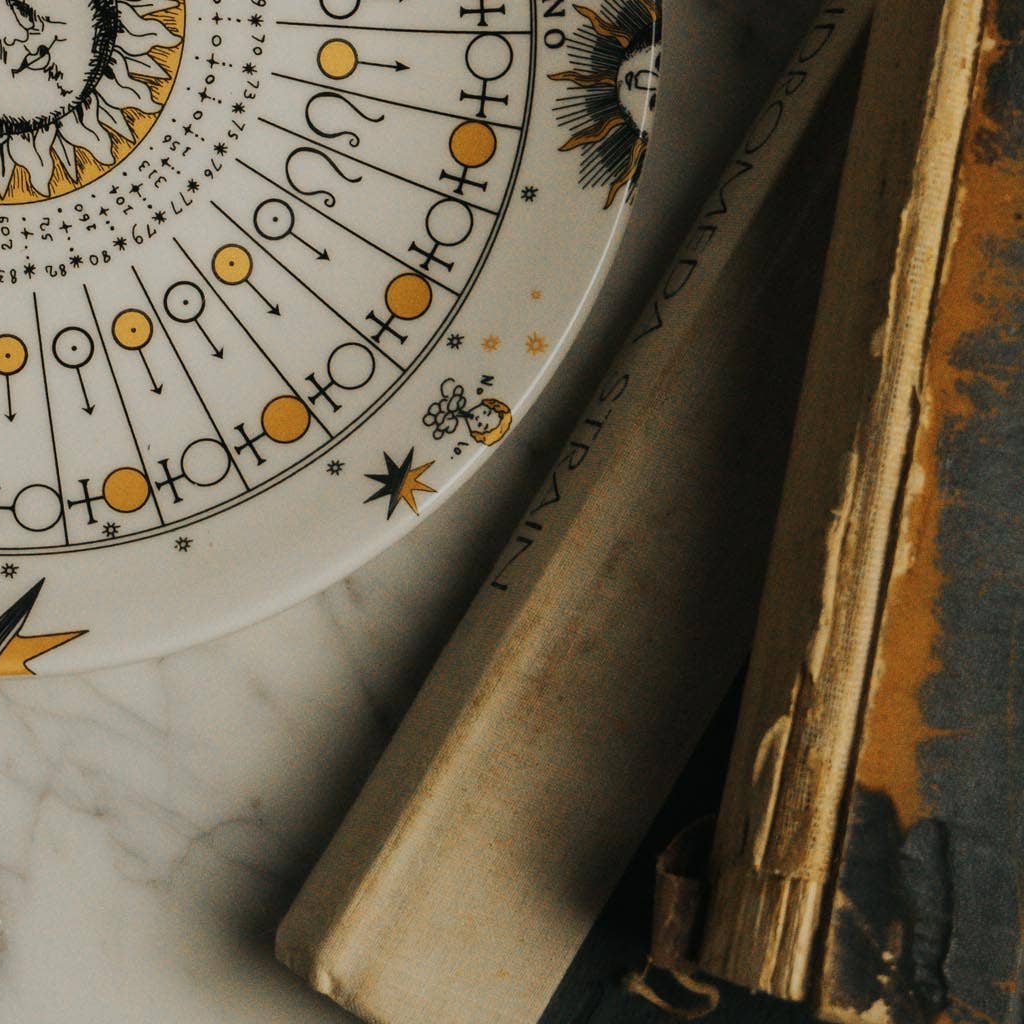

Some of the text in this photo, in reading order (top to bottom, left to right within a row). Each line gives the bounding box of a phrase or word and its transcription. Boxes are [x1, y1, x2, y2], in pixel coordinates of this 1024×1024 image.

[251, 34, 265, 56] 70
[244, 81, 259, 99] 73
[228, 120, 245, 140] 75
[204, 158, 222, 180] 76
[171, 192, 193, 215] 77
[132, 224, 157, 245] 79
[89, 250, 111, 266] 80
[45, 264, 67, 278] 82
[491, 374, 630, 591] STRAIN
